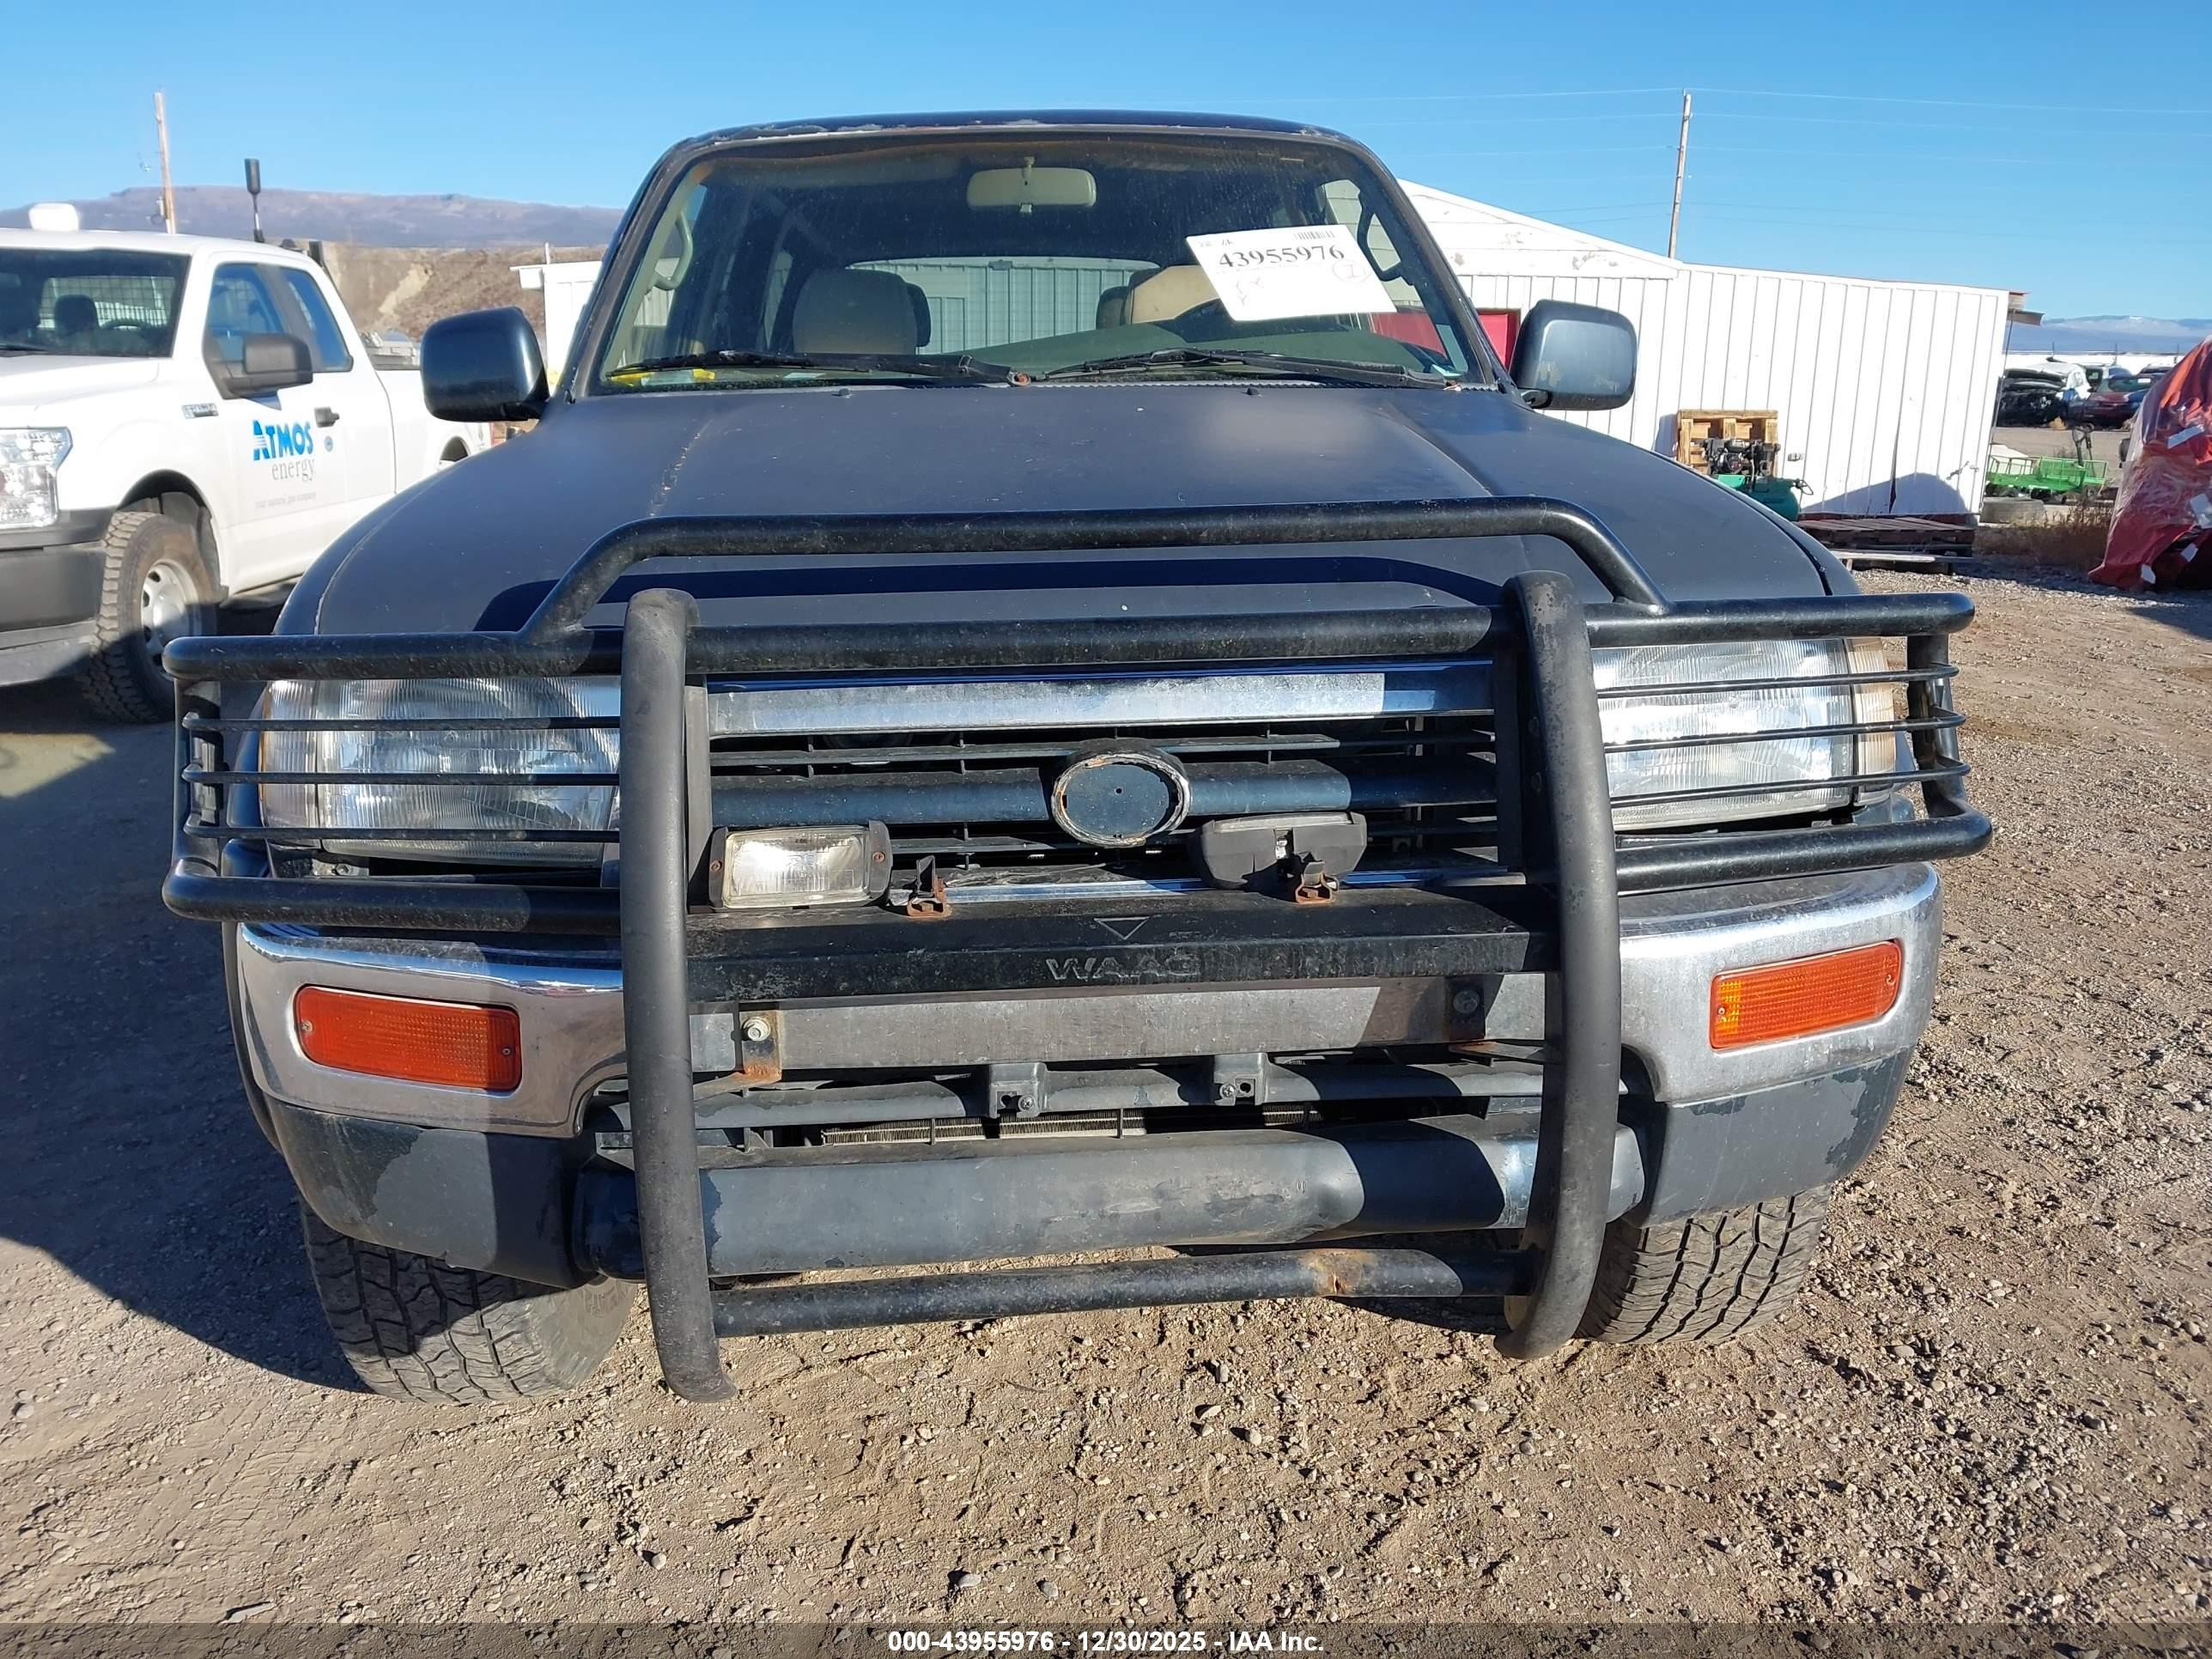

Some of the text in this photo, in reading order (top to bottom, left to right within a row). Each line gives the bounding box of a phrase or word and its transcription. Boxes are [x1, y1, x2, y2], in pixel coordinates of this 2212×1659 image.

[1218, 244, 1345, 268] 43955976
[252, 419, 314, 461] ATMOS
[271, 459, 315, 482] energy
